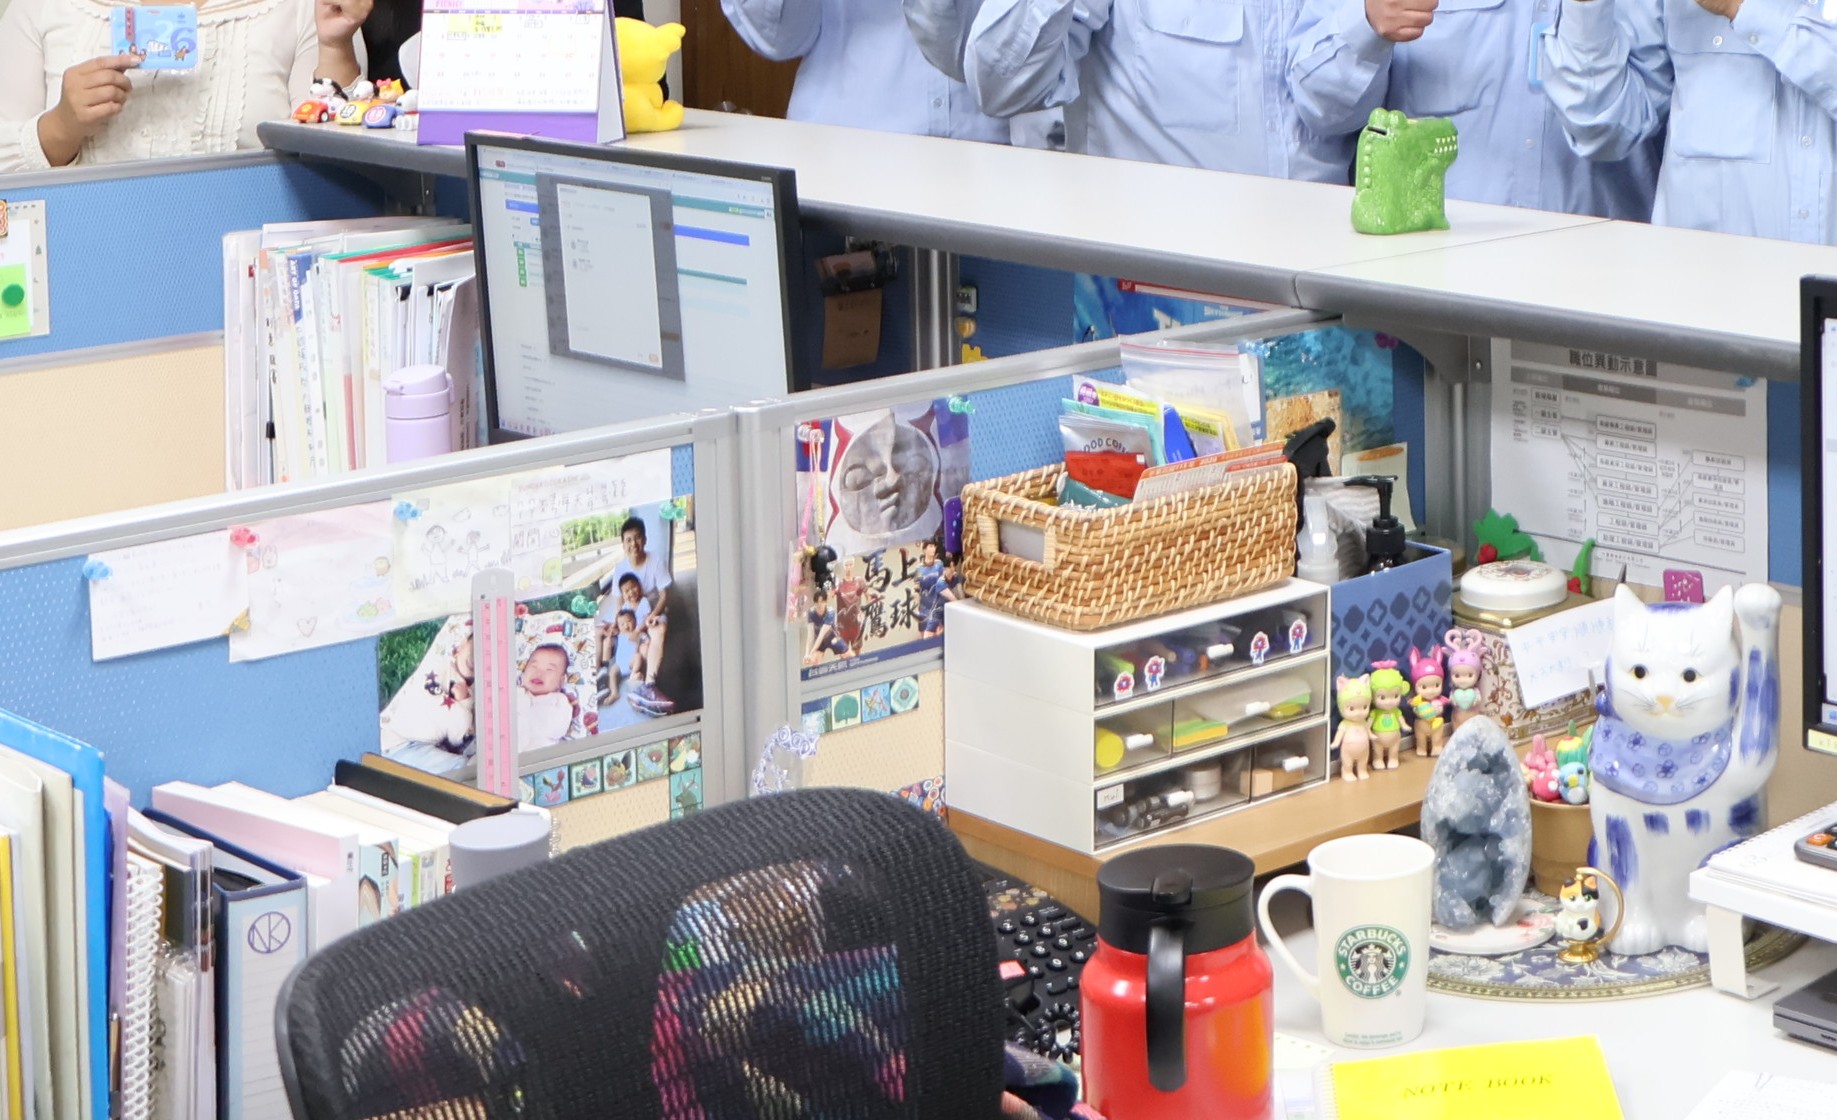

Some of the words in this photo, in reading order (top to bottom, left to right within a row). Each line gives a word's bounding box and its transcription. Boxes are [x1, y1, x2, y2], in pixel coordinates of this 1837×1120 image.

[1569, 350, 1657, 376] 職位異動示意圖
[861, 547, 919, 593] 馬上
[856, 587, 923, 642] 鷹球
[1338, 928, 1407, 957] STARBUCKS
[1345, 975, 1398, 996] COFFEE
[1402, 1080, 1473, 1100] NOTE
[1486, 1073, 1553, 1089] BOOK
